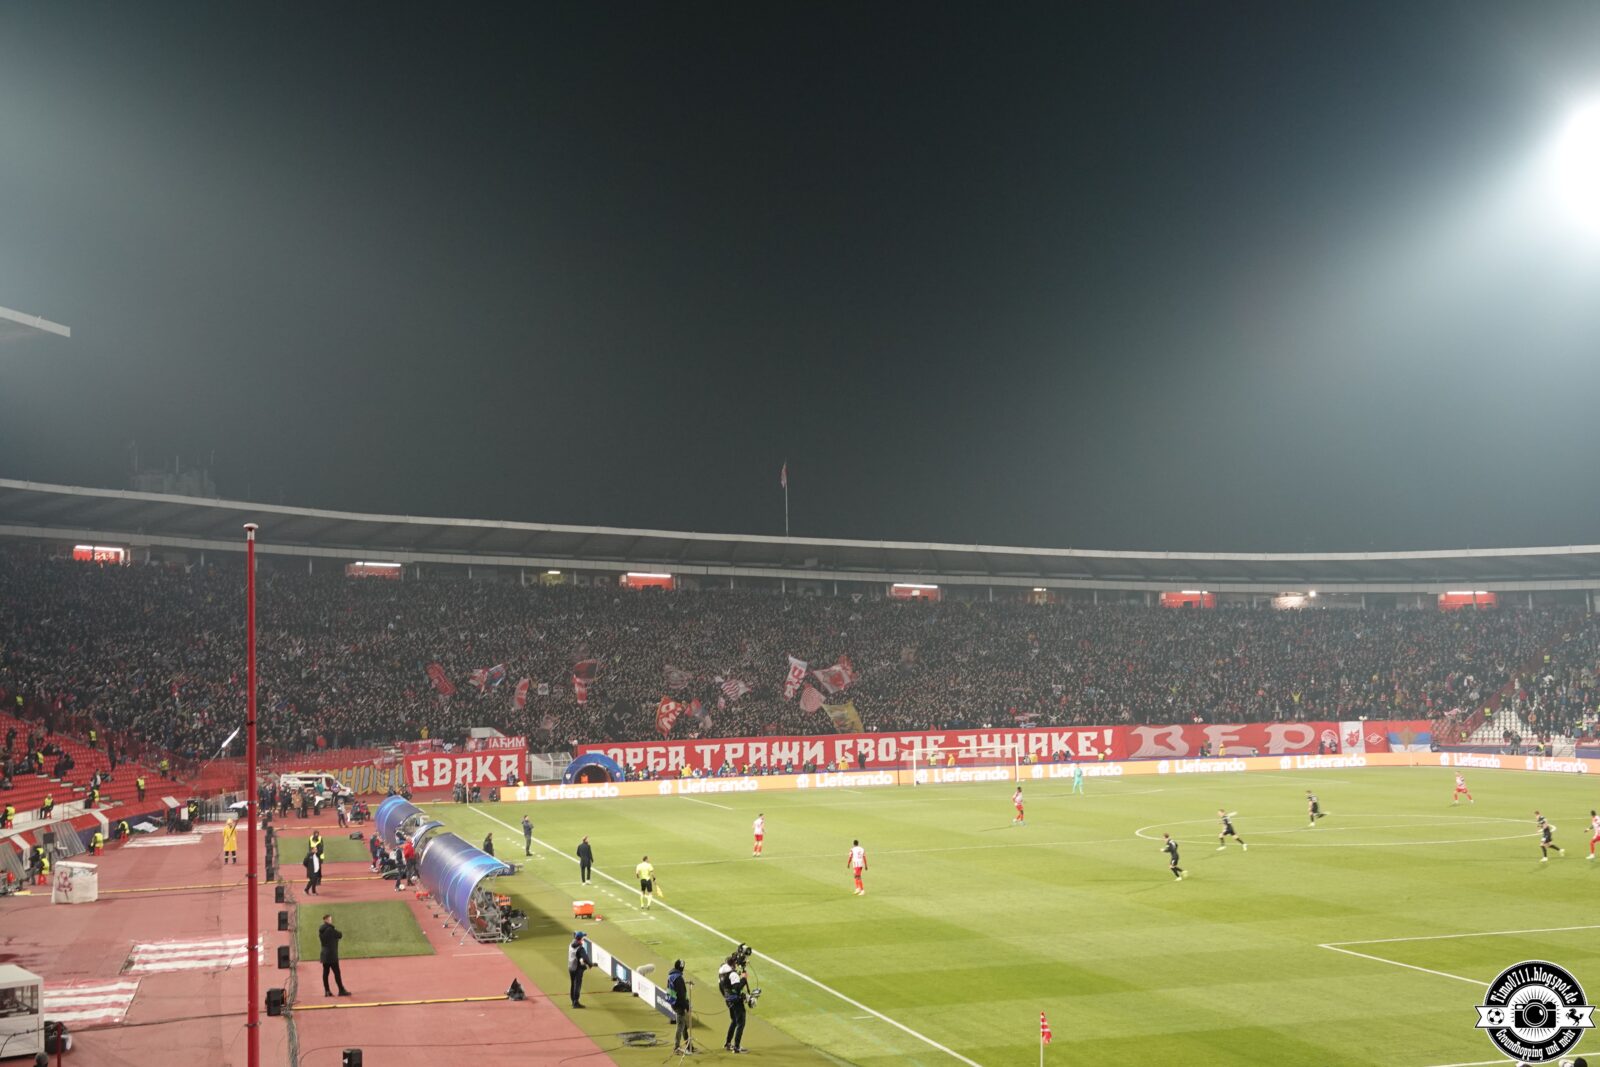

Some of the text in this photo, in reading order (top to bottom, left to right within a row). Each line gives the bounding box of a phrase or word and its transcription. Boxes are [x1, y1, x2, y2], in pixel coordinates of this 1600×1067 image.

[586, 729, 1113, 772] ОРБА ТРАЖИ СВОЈЕ ЈУНАКЕ!
[1174, 758, 1247, 773] Lieferando
[1296, 753, 1366, 769] Lieferando
[1454, 752, 1501, 768] Lieferando
[1537, 756, 1588, 773] Lieferando
[410, 754, 519, 788] СВАКА
[934, 767, 1009, 783] Lieferando
[1049, 762, 1123, 778] Liefrando
[678, 775, 759, 795] Lieferando
[815, 771, 893, 788] Lieferando
[536, 783, 619, 800] Lieferando
